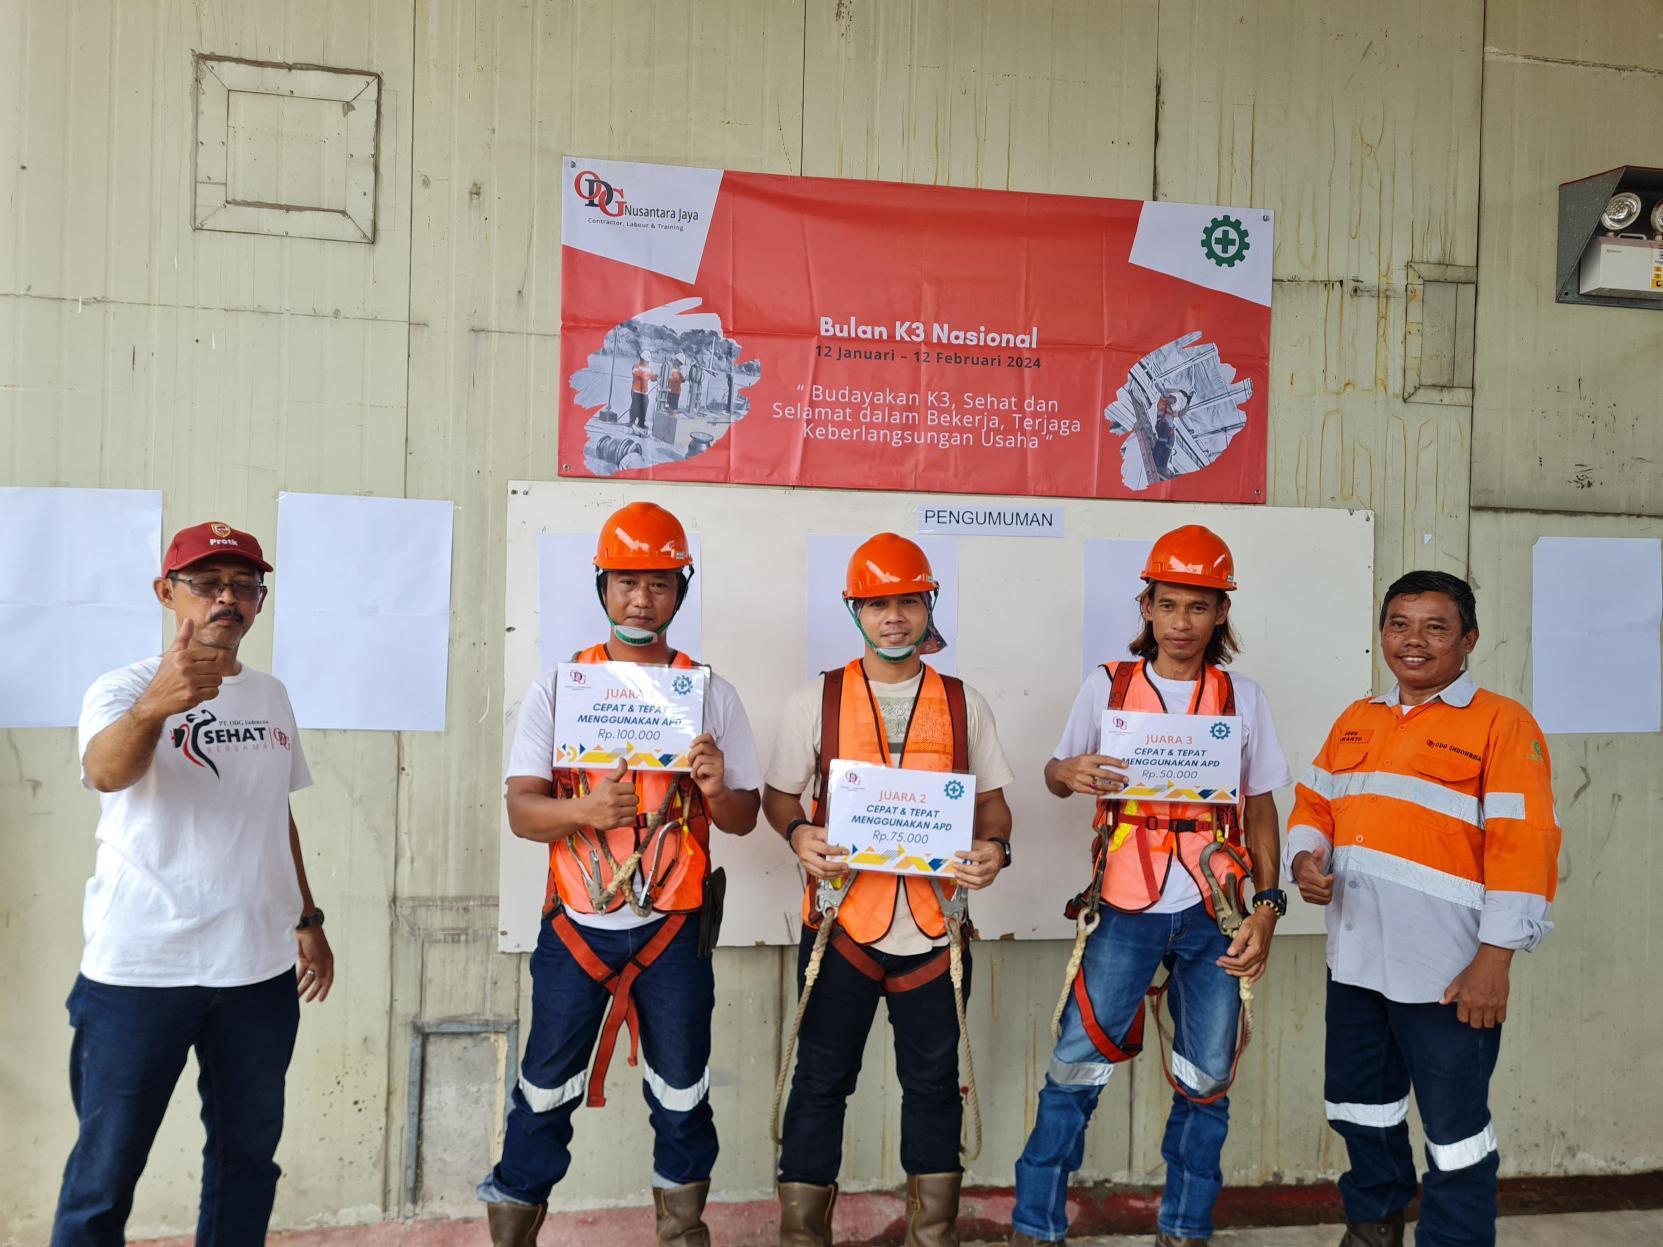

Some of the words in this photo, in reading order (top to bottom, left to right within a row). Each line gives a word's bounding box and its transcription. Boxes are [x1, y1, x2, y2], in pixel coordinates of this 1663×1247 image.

[624, 205, 676, 219] Nusantara
[678, 208, 699, 224] Jaya
[588, 217, 625, 227] Contractor,
[626, 221, 649, 229] Labour
[658, 223, 684, 232] Training
[820, 316, 888, 341] Bulan
[895, 321, 924, 342] K3
[932, 323, 1038, 349] Nasional
[815, 345, 832, 358] 12
[837, 345, 895, 361] Januari
[914, 351, 930, 363] 12
[936, 352, 1001, 367] Februari
[1007, 356, 1041, 369] 2024
[812, 385, 920, 407] Budayakan
[927, 391, 956, 410] K3,
[963, 393, 1018, 411] Sehat
[1023, 394, 1059, 412] dan
[772, 402, 852, 421] Selamat
[859, 406, 919, 425] dalam
[927, 410, 1004, 432] Bekerja,
[1012, 413, 1081, 436] Terjaga
[803, 422, 974, 448] Keberlangsungan
[981, 430, 1039, 449] Usaha
[924, 509, 1053, 527] PENGUMUMAN
[592, 703, 626, 713] CEPAT
[628, 705, 634, 713] &
[577, 715, 660, 726] MENGGUNAKAN
[203, 727, 266, 745] SEHAT
[597, 728, 661, 742] Rp.100.000
[1145, 734, 1183, 745] JUARA
[1186, 736, 1193, 745] 3
[1134, 747, 1165, 756] CEPAT
[1177, 749, 1207, 757] TEPAT
[1122, 757, 1198, 767] MENGGUNAKAN
[1141, 769, 1198, 780] Rp.50.000
[878, 790, 917, 803] JUARA
[920, 794, 927, 803] 2
[866, 804, 898, 814] CEPAT
[910, 808, 940, 818] TEPAT
[851, 815, 931, 829] MENGGUNAKAN
[933, 822, 952, 831] APD
[872, 830, 929, 844] Rp.75.000
